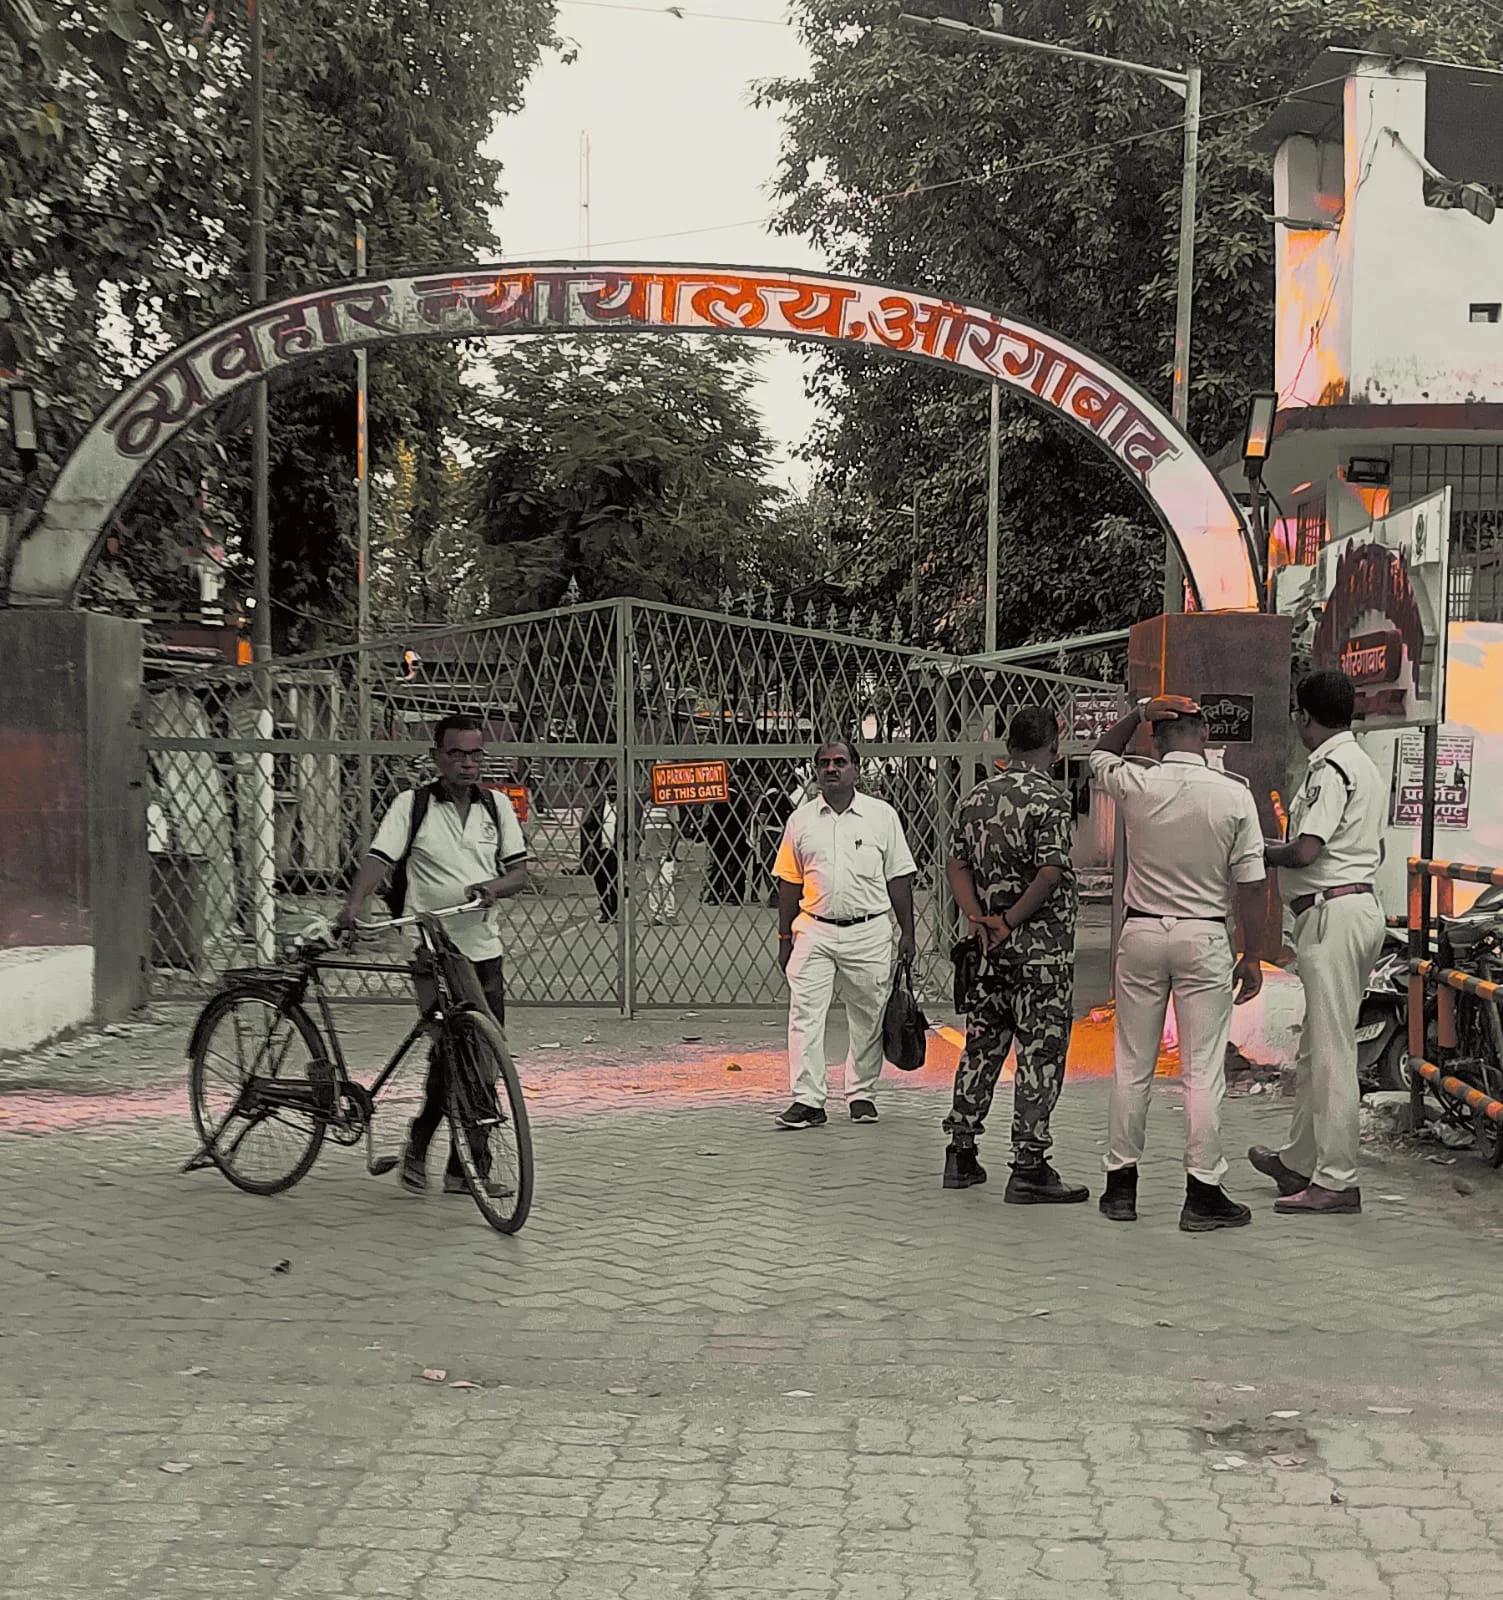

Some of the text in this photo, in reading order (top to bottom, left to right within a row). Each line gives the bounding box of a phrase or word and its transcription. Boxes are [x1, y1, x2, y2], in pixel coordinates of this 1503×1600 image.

[104, 285, 401, 457] व्यवहार
[656, 769, 666, 786] NO
[667, 767, 695, 784] PARKING
[658, 785, 723, 800] OF THIS GATE
